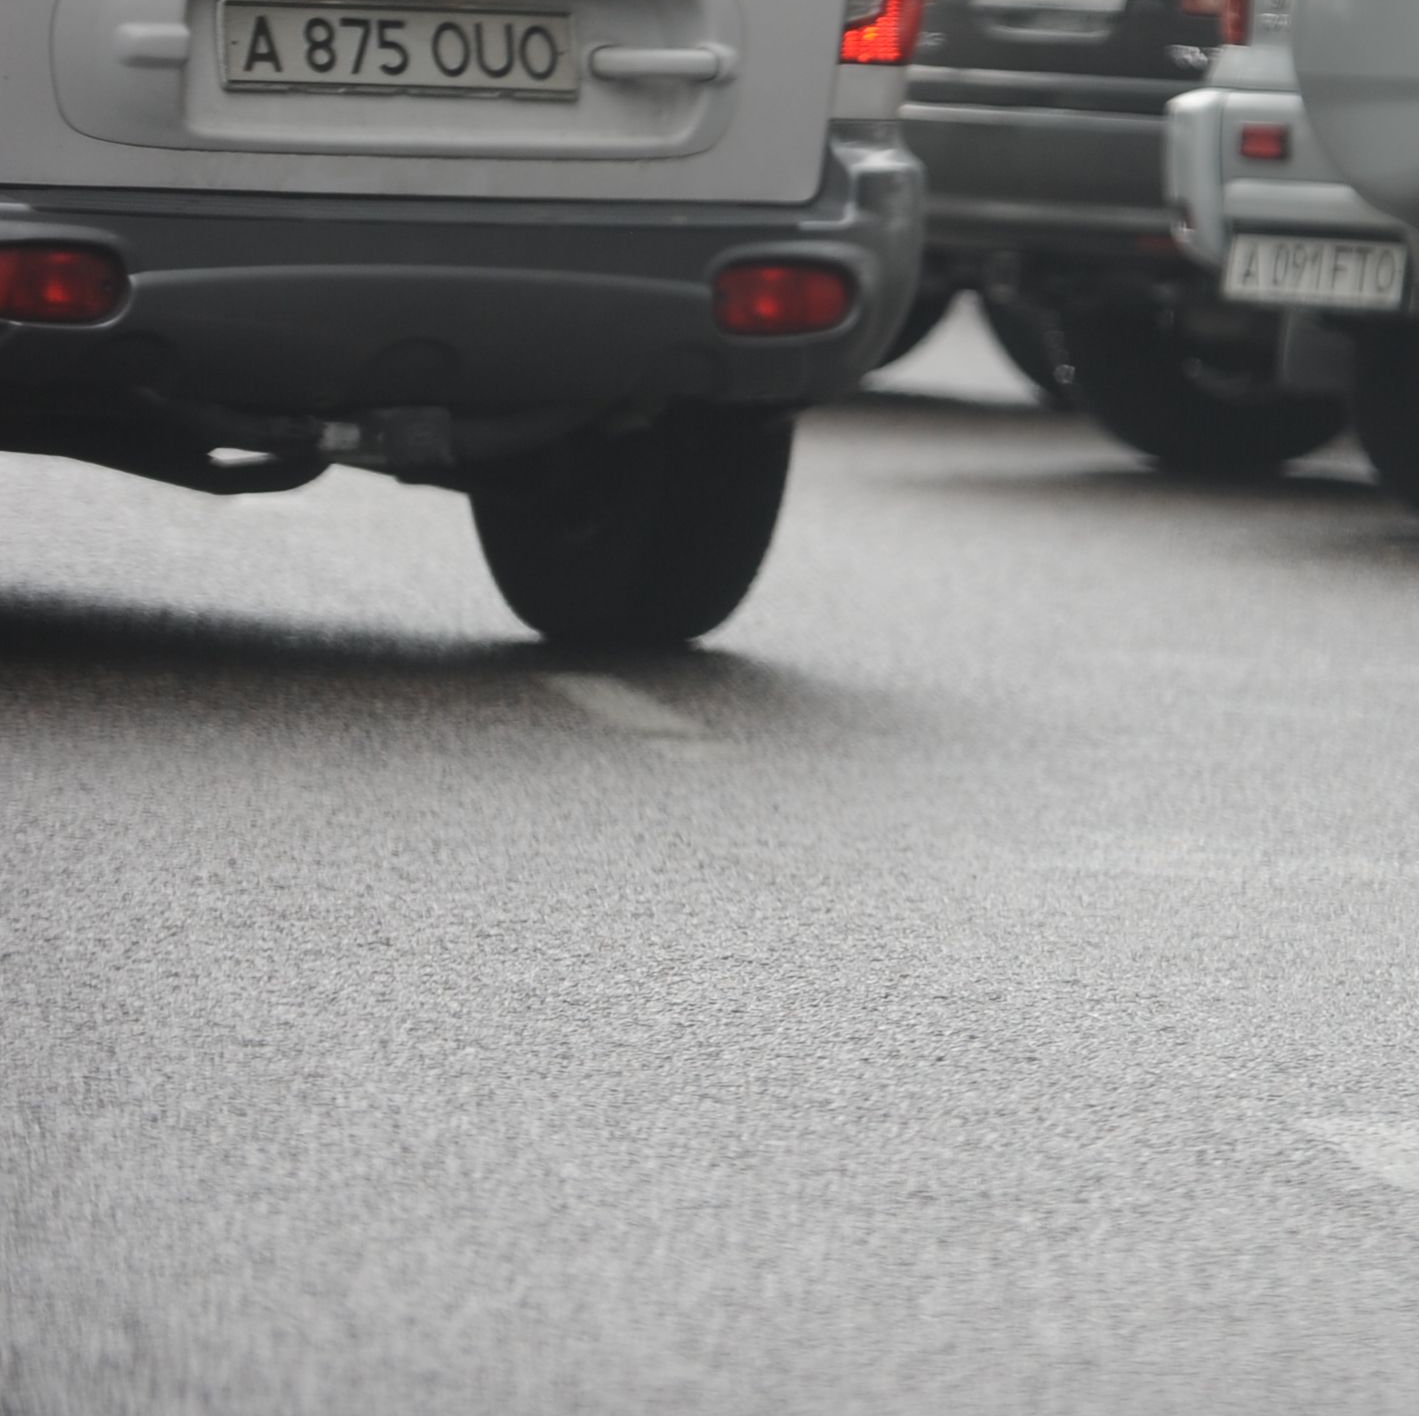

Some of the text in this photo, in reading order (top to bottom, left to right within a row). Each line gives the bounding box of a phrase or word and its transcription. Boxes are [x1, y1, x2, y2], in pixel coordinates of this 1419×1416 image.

[243, 15, 559, 81] A 875 OUO
